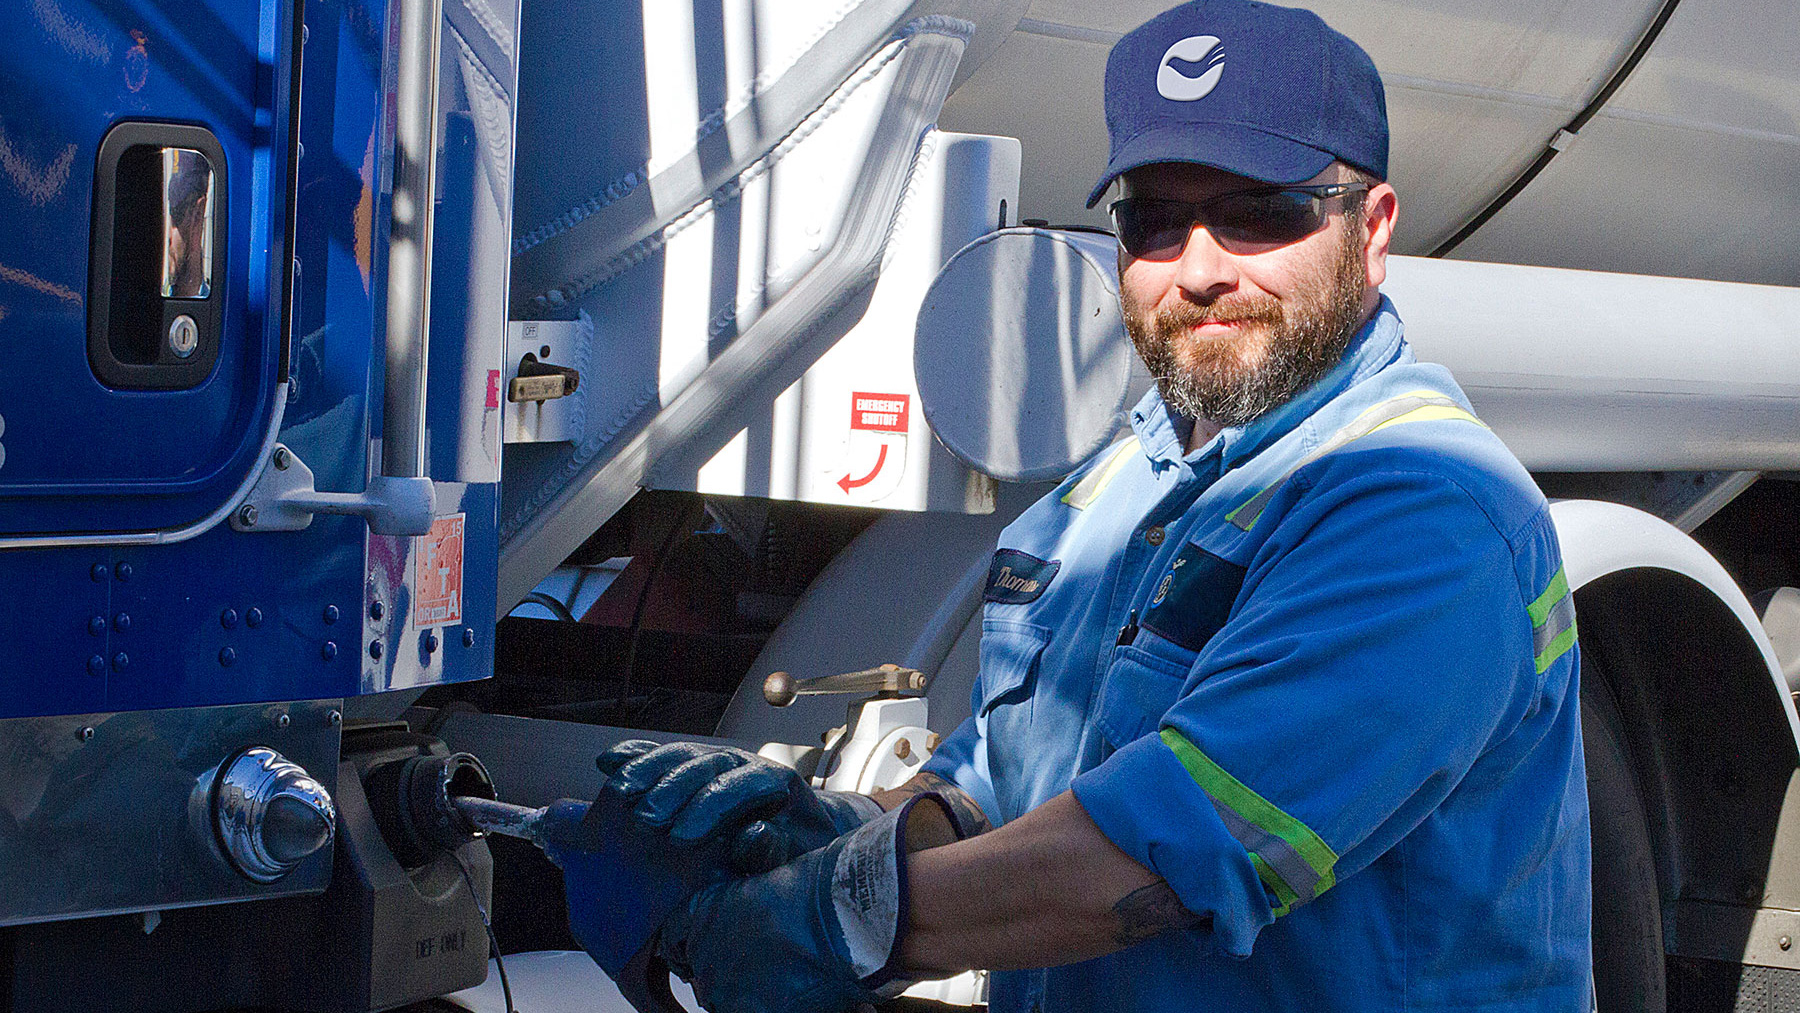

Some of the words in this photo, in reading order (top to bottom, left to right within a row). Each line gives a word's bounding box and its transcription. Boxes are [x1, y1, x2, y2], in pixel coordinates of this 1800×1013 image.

[525, 326, 536, 336] OFF
[856, 399, 905, 413] EMERGENCY
[861, 412, 898, 426] SHUTOFF
[416, 937, 435, 959] DEF
